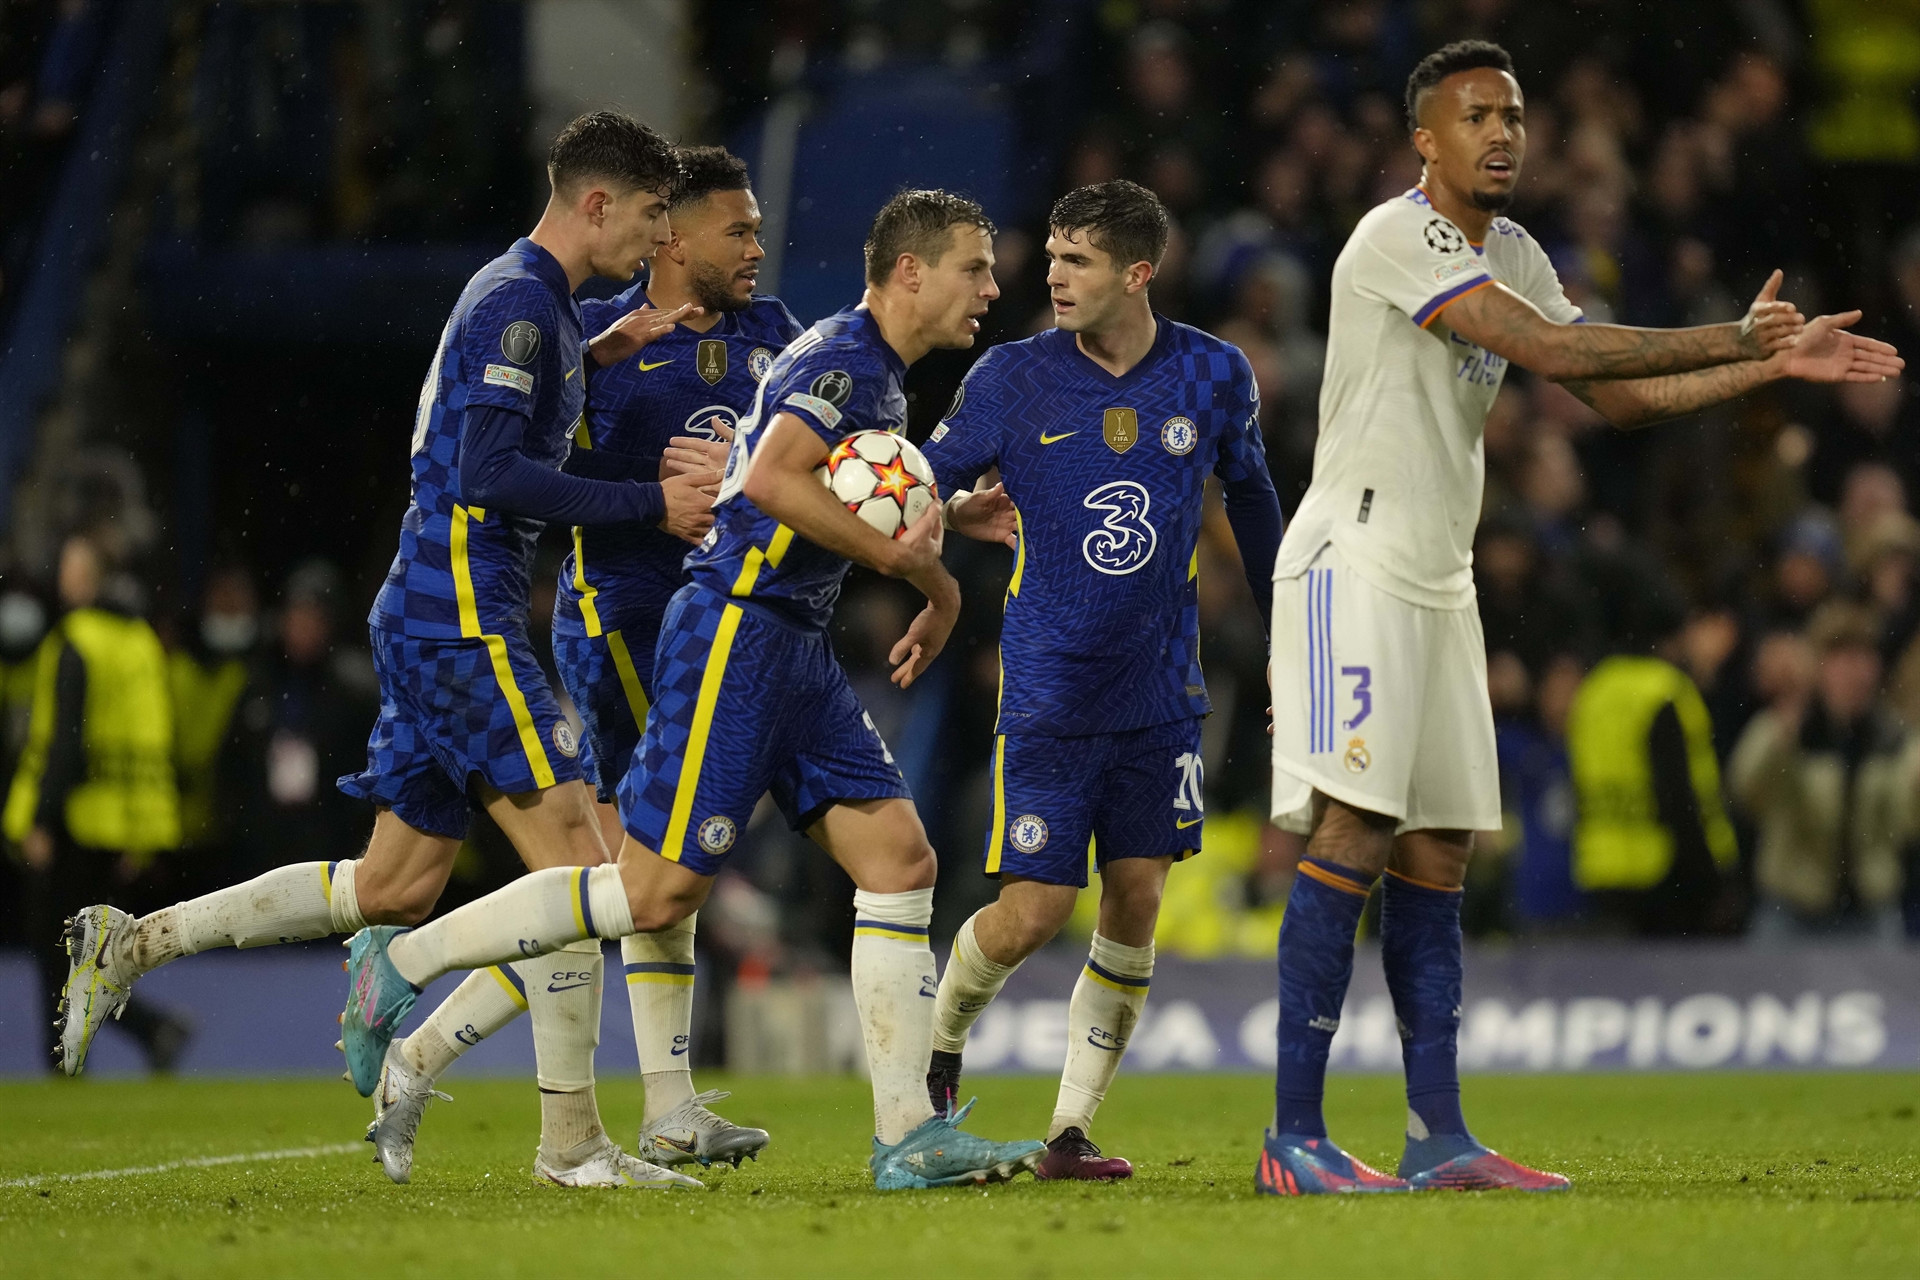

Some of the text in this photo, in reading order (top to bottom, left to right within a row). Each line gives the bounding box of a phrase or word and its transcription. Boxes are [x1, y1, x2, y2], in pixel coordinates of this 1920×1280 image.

[1168, 418, 1191, 427] CHELSEA
[1341, 666, 1371, 731] 3
[1173, 752, 1204, 812] 10
[551, 971, 592, 981] CFC
[1090, 1026, 1126, 1046] CFC
